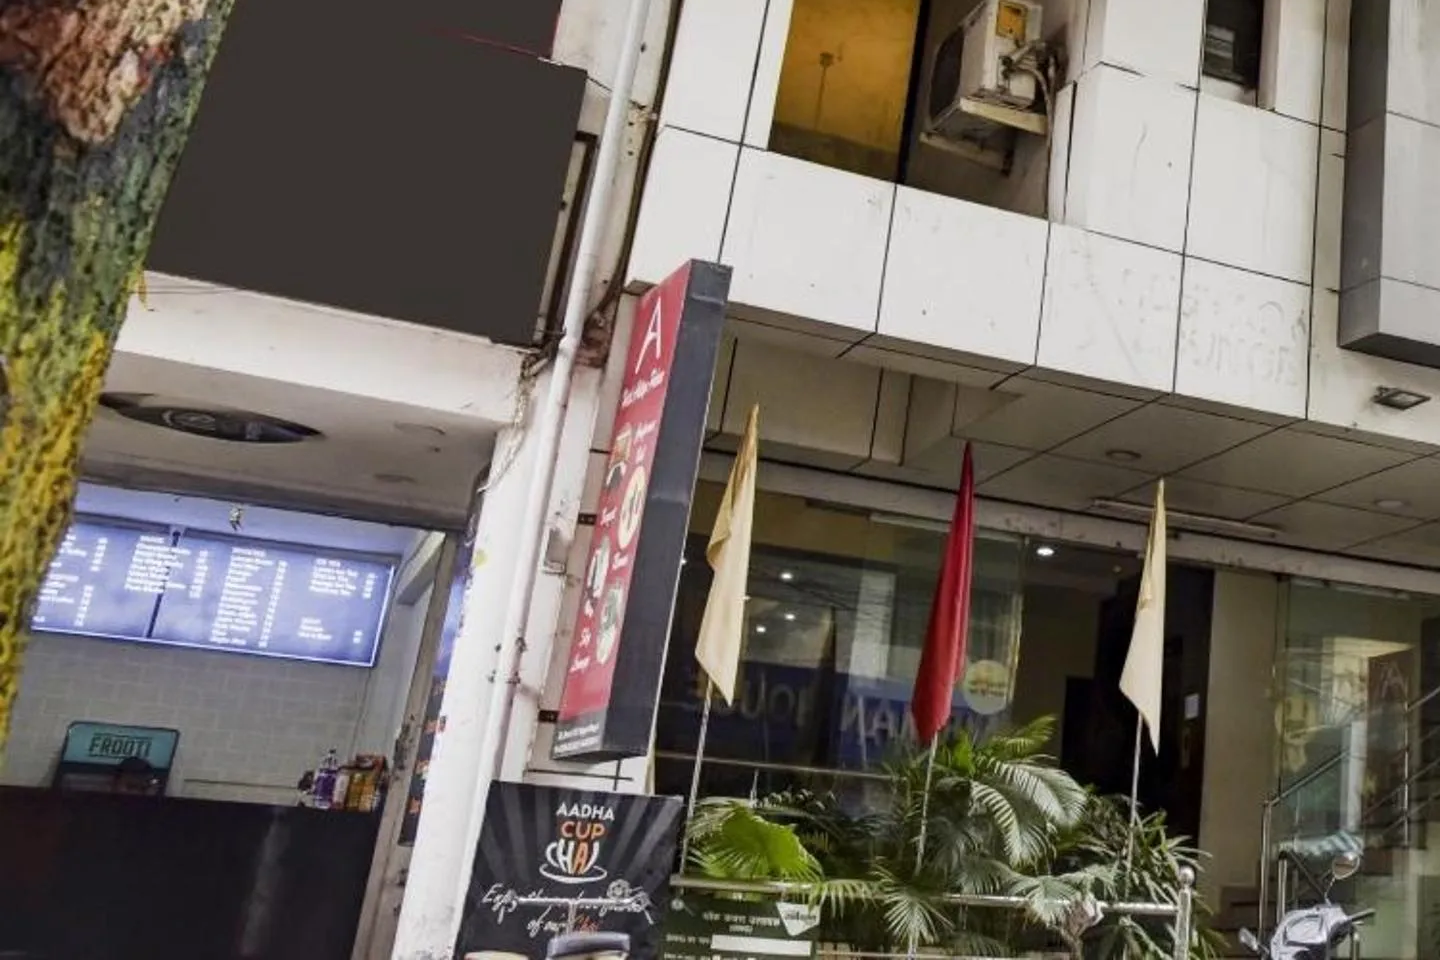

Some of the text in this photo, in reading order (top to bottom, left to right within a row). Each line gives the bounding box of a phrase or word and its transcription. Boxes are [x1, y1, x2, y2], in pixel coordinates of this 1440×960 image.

[634, 297, 662, 374] A
[89, 736, 153, 757] FROOTI
[556, 802, 615, 822] AADHA
[561, 821, 605, 840] CUP
